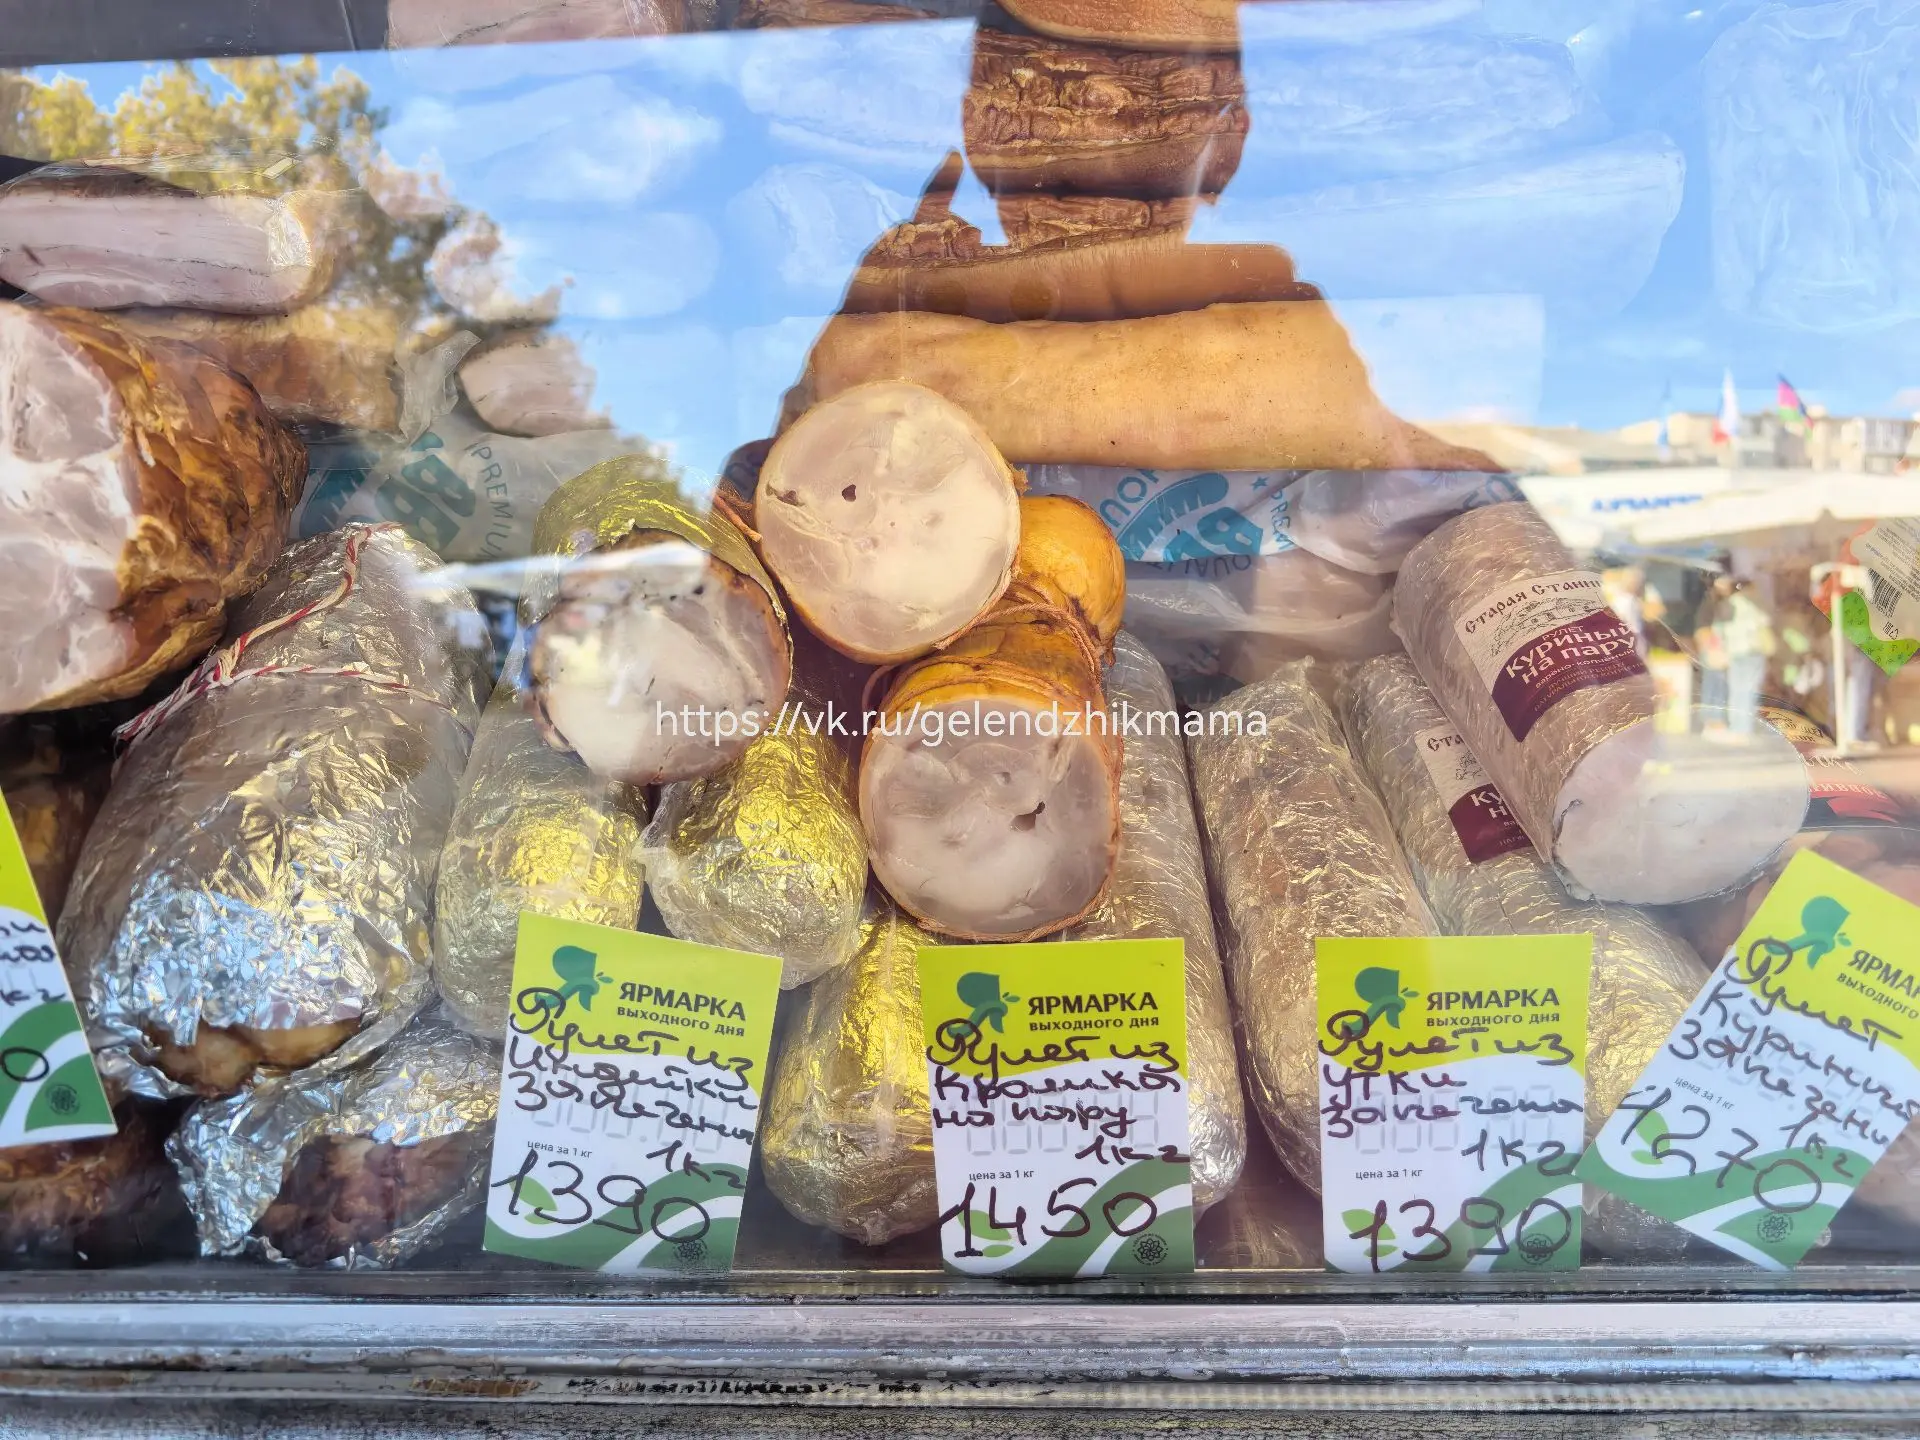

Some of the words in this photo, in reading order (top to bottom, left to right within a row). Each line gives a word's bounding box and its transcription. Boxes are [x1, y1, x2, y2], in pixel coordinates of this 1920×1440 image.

[1560, 636, 1636, 661] пару
[619, 981, 747, 1022] ЯРМАРКА
[1028, 991, 1158, 1016] ЯРМАРКА
[1426, 987, 1561, 1012] ЯРМАРКА
[1673, 1077, 1701, 1097] цена
[1700, 1088, 1715, 1102] за
[1722, 1098, 1736, 1112] кг
[527, 1139, 554, 1152] цена
[556, 1144, 569, 1155] за
[580, 1148, 593, 1159] кг
[968, 1169, 997, 1183] цена
[998, 1169, 1013, 1180] за
[1014, 1169, 1021, 1179] 1
[1022, 1168, 1036, 1180] кг
[1355, 1168, 1384, 1182] цена
[1386, 1168, 1400, 1180] за
[1402, 1168, 1408, 1179] 1
[1410, 1167, 1424, 1178] кг
[490, 1148, 712, 1244] 1390
[938, 1177, 1158, 1258] 1450
[1349, 1196, 1573, 1274] 1390
